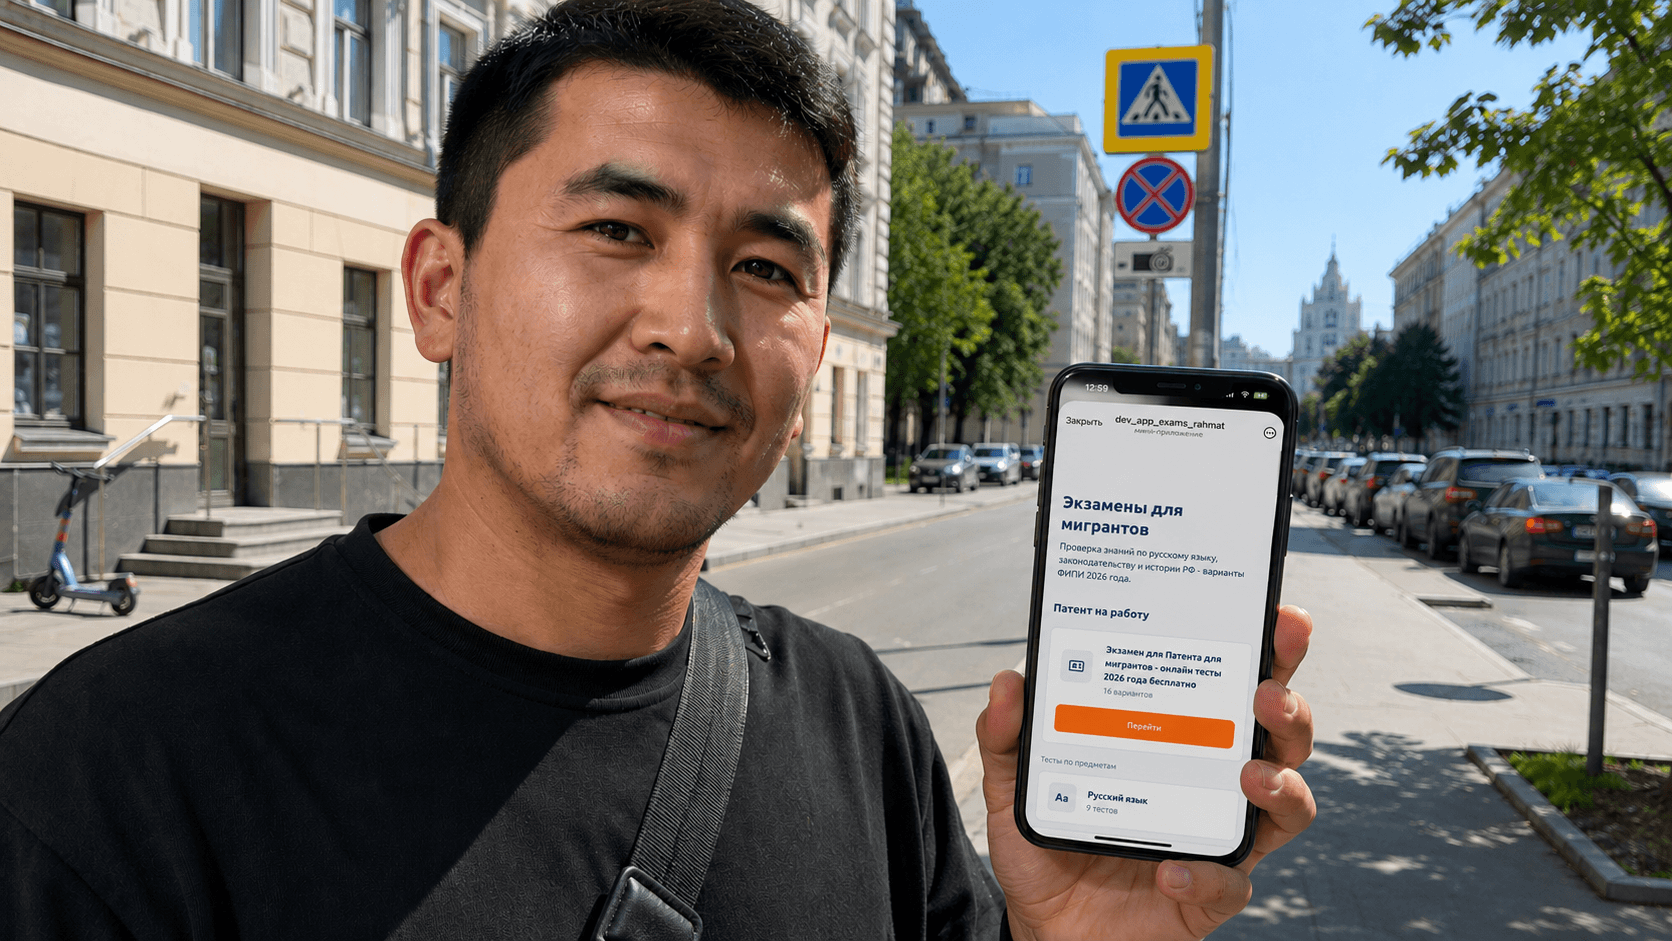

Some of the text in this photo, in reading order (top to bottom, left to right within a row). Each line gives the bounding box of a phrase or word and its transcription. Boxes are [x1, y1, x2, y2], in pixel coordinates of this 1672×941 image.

[1085, 383, 1109, 393] 12:59
[1066, 417, 1103, 427] Закрыть
[1115, 416, 1225, 430] dev_app_exams_rahmat
[1063, 496, 1183, 517] Экзамены для
[1061, 520, 1149, 536] мигрантов
[1060, 542, 1101, 554] Проверка
[1104, 547, 1135, 556] знаний
[1149, 551, 1189, 561] русскому
[1191, 555, 1218, 564] языку,
[1058, 557, 1136, 571] законодательству
[1145, 565, 1180, 573] истории
[1203, 569, 1244, 577] варианты
[1058, 570, 1084, 578] ФИПИ
[1087, 572, 1107, 580] 2026
[1054, 604, 1093, 615] Патент
[1110, 609, 1149, 621] работу
[1106, 646, 1144, 656] Экзамен
[1166, 651, 1202, 661] Патента
[1105, 661, 1153, 672] мигрантов
[1160, 666, 1193, 674] онлайн
[1195, 669, 1221, 677] тесты
[1104, 673, 1124, 682] 2026
[1149, 677, 1196, 688] бесплатно
[1113, 690, 1153, 699] вариантов
[1127, 722, 1162, 732] Перейти
[1041, 756, 1062, 764] Тесты
[1075, 761, 1116, 769] предметам
[1088, 791, 1148, 805] Русский язык
[1086, 804, 1091, 812] 9
